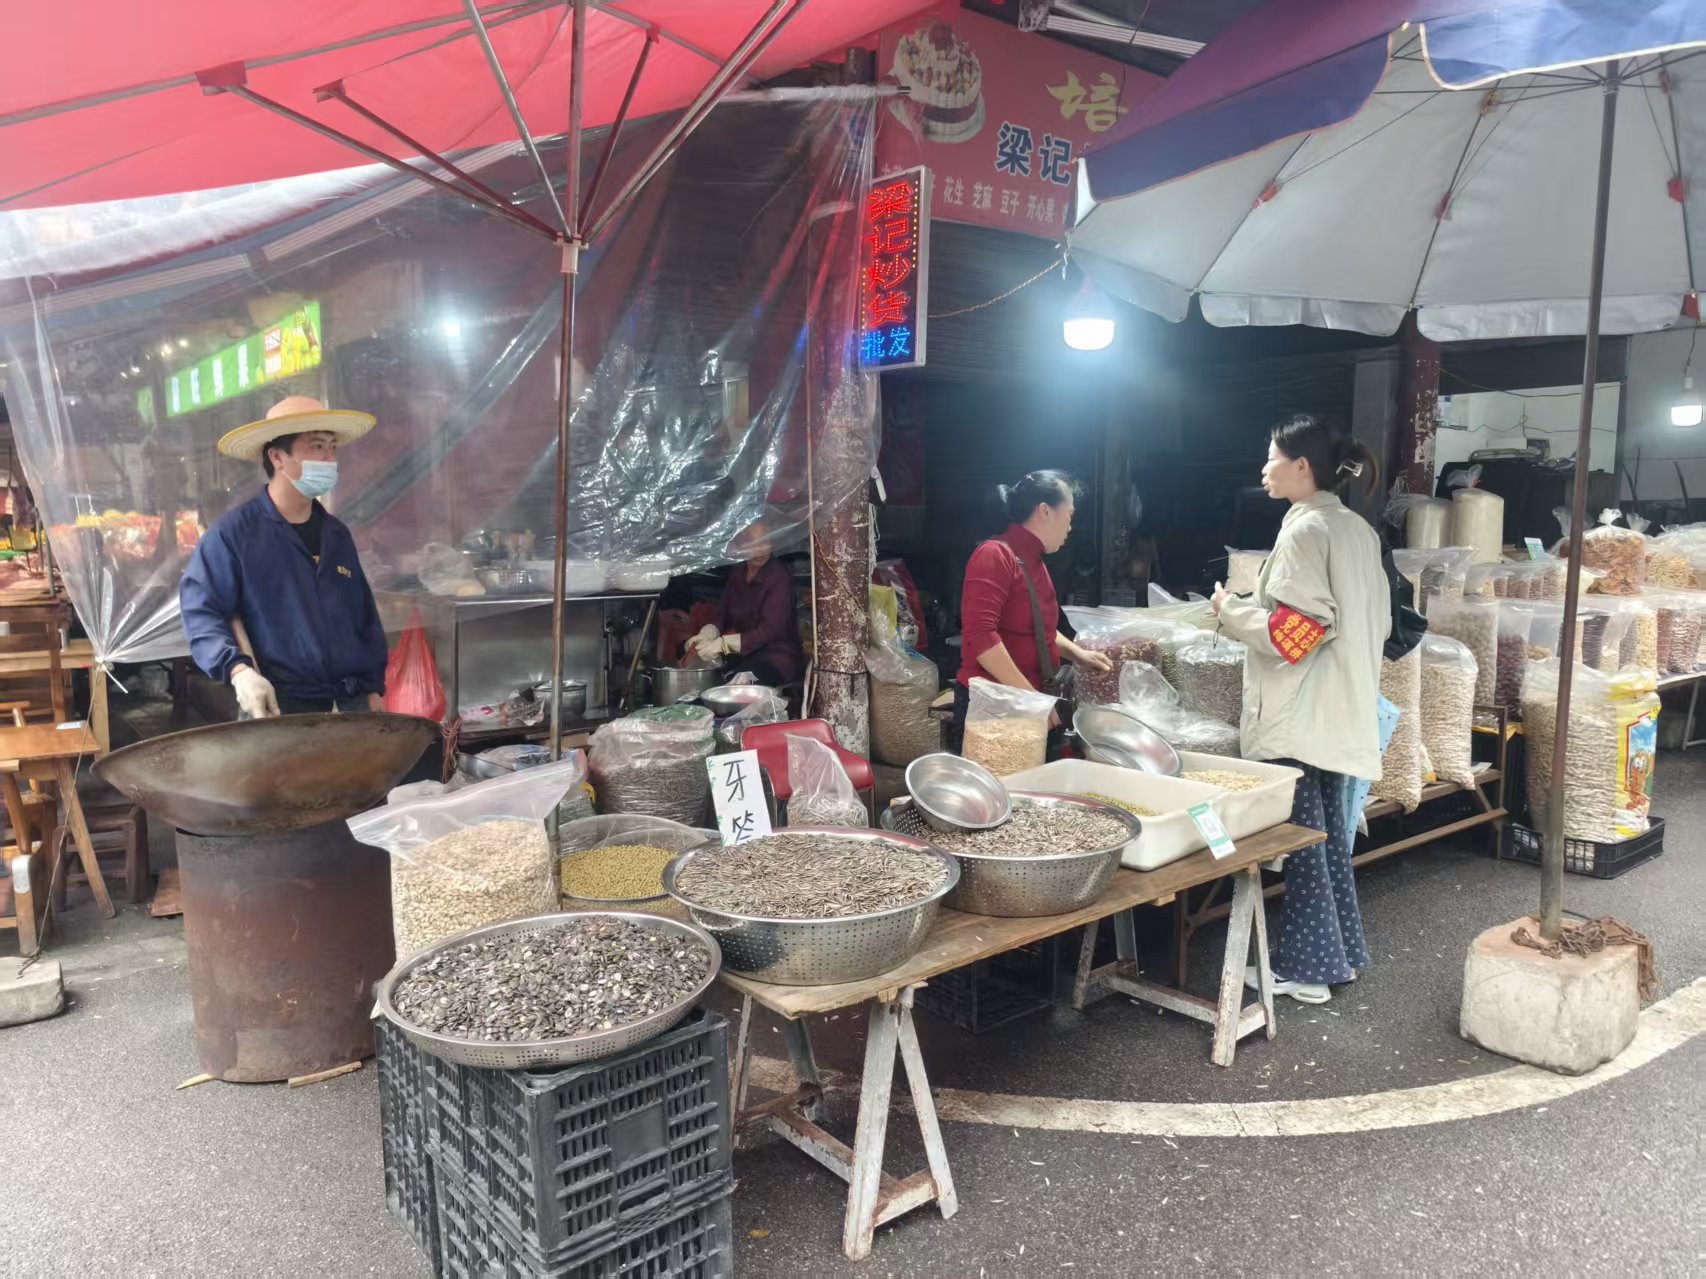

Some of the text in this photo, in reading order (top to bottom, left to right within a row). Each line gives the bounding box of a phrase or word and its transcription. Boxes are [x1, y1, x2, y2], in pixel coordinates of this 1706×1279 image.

[995, 121, 1091, 187] 梁记
[944, 175, 965, 206] 花生
[972, 181, 994, 209] 芝麻
[1000, 189, 1020, 217] 豆子
[1027, 195, 1055, 224] 开心果
[863, 181, 913, 328] 梁记炒货
[863, 327, 911, 360] 批发
[1279, 613, 1323, 652] 党员志
